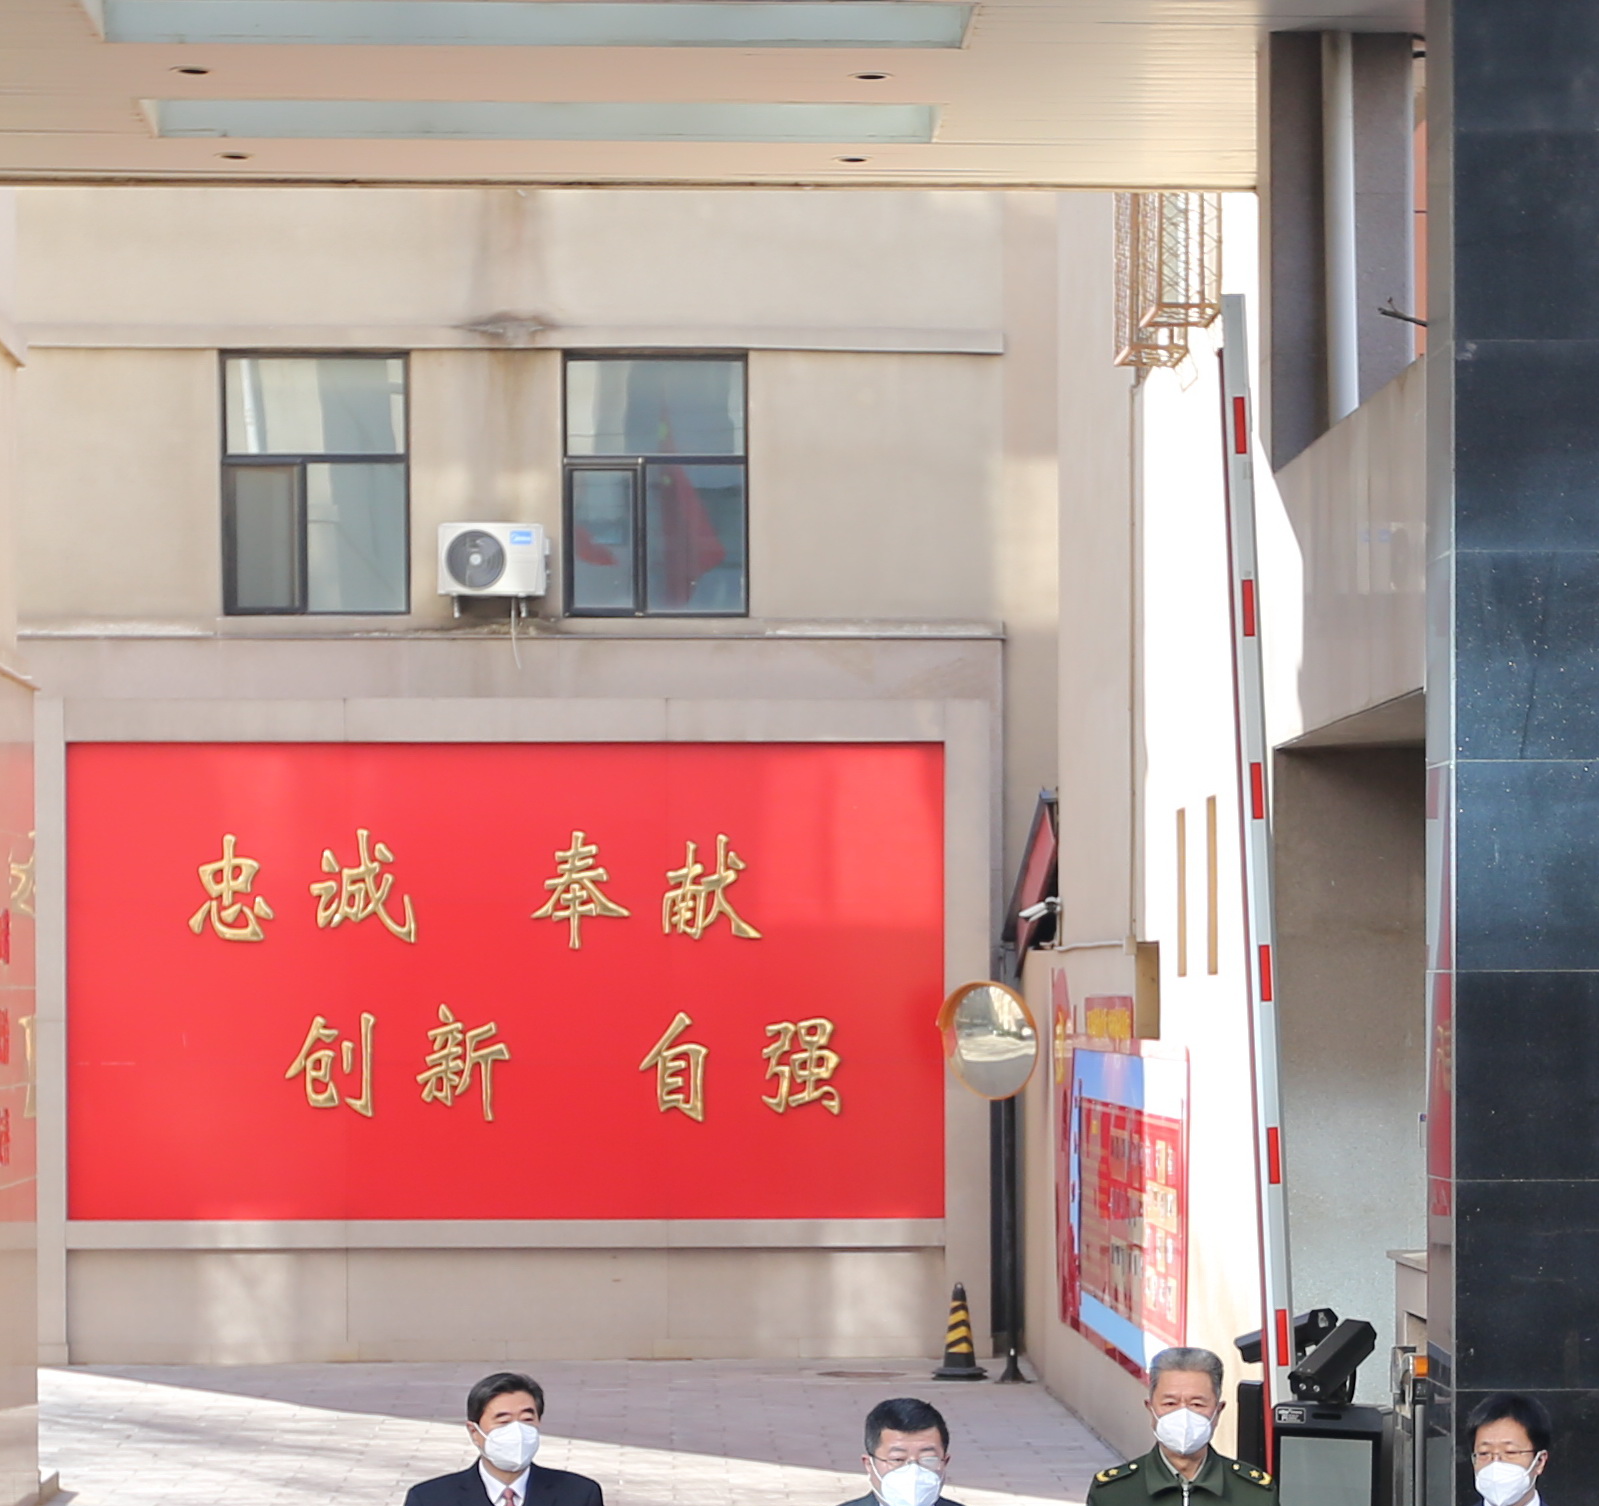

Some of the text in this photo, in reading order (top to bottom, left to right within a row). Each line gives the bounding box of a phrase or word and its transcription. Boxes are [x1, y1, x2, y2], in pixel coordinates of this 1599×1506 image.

[187, 828, 763, 949] 忠诚 奉献
[284, 1003, 843, 1123] 创新 自强
